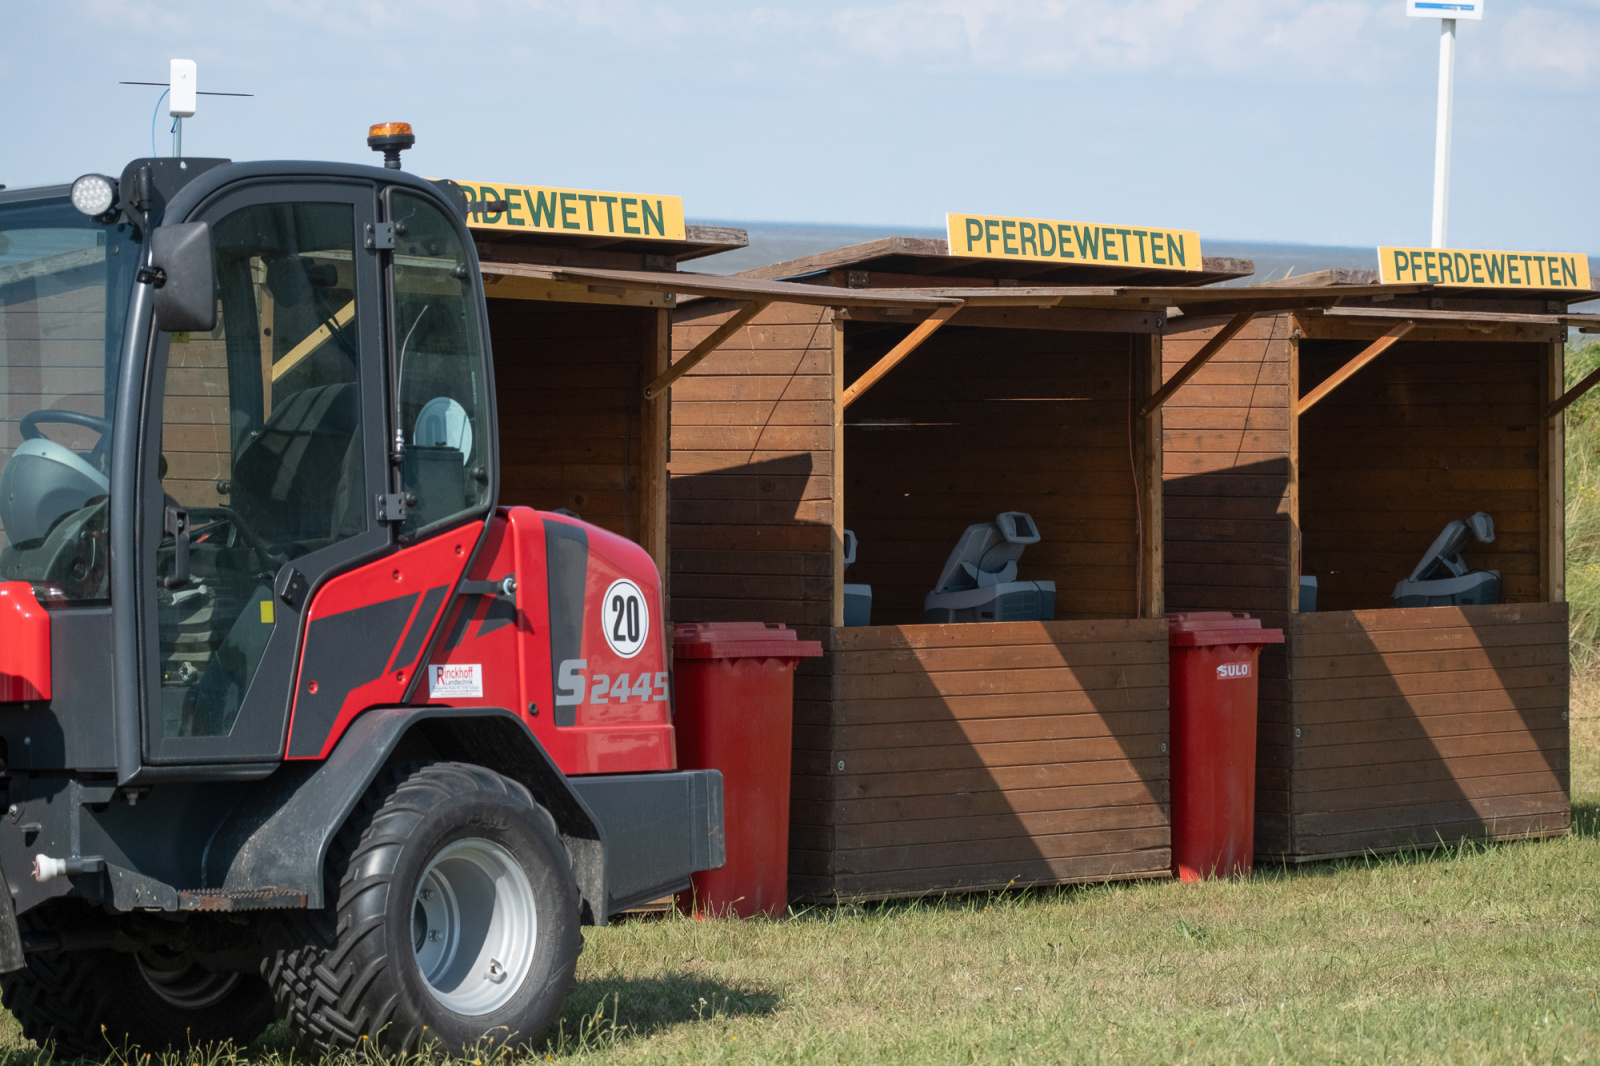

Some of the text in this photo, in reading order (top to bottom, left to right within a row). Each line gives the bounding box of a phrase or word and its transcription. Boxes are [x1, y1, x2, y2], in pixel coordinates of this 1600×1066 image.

[965, 217, 1187, 267] PFERDEWETTEN
[1393, 250, 1578, 287] PFERDEWETTEN
[611, 594, 641, 643] 20
[436, 665, 474, 686] Rinckhoff
[1219, 664, 1248, 677] SULO
